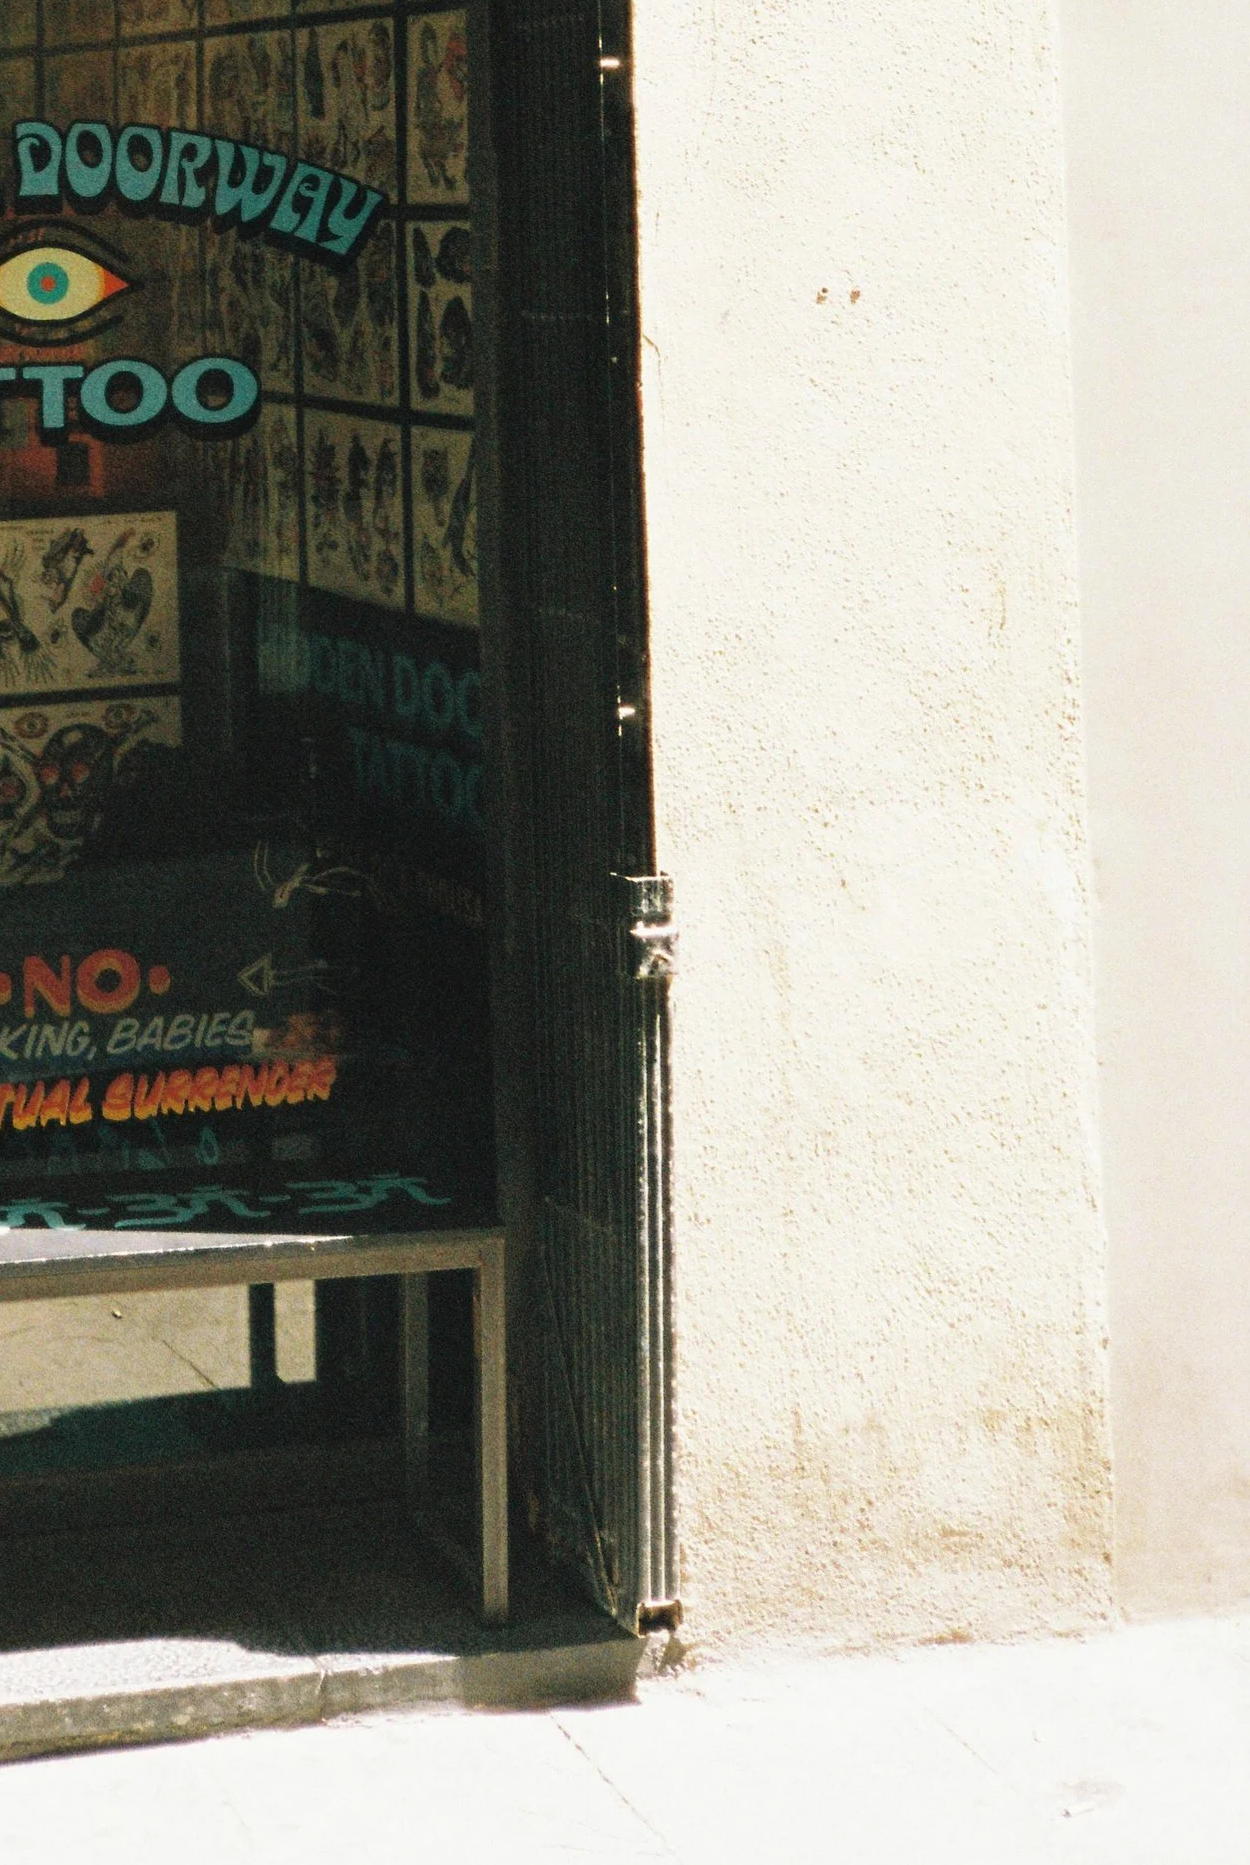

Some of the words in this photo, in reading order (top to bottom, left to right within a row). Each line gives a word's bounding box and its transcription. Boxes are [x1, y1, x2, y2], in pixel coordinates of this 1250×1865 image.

[15, 120, 385, 258] DOORWAY
[105, 1008, 257, 1057] BABIES
[102, 1057, 338, 1122] SURRENDER
